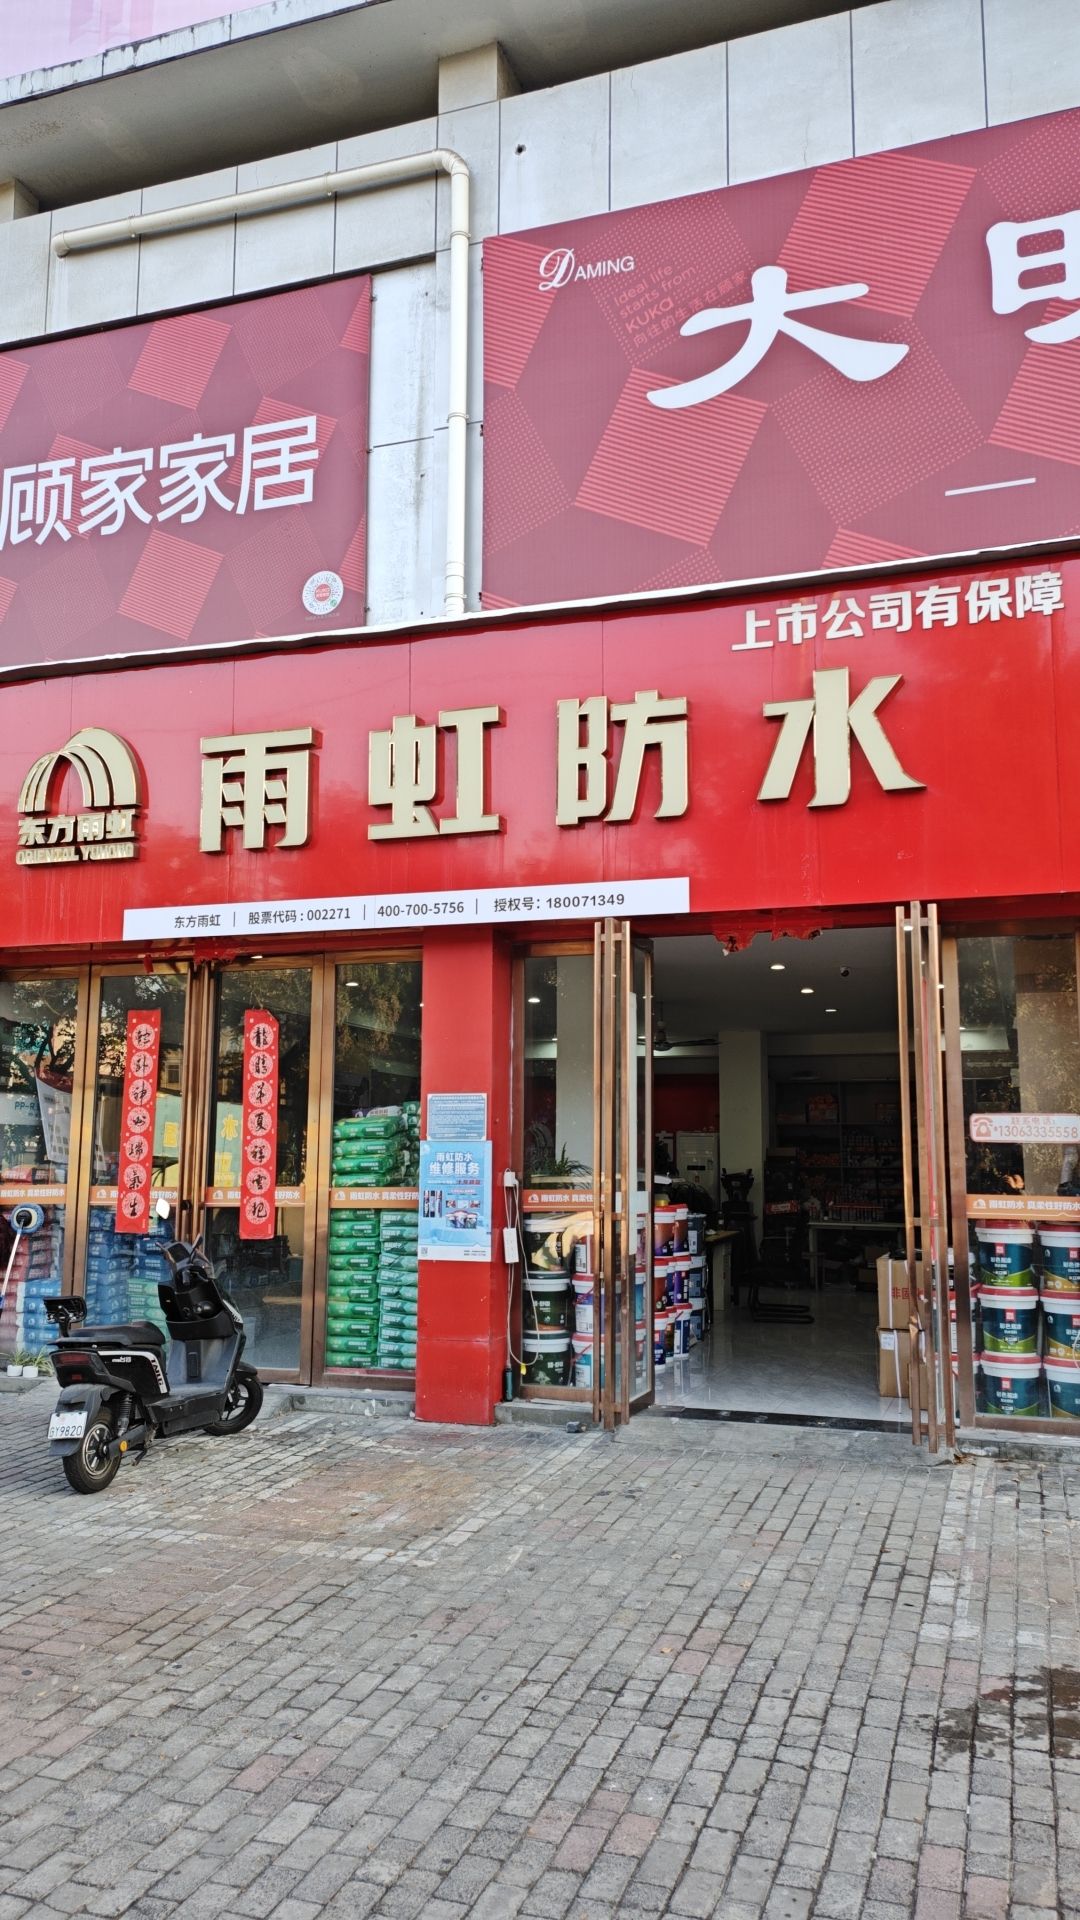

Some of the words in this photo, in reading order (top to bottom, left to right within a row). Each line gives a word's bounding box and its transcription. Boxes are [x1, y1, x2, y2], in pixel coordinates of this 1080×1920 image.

[652, 265, 674, 285] life
[620, 290, 660, 319] starts
[661, 266, 697, 294] from
[731, 571, 1065, 652] 上市公司有保障
[200, 667, 927, 853] 雨虹防水
[17, 808, 136, 846] 东方雨虹
[15, 846, 79, 865] ORIENTAL
[174, 914, 221, 929] 东方雨虹
[377, 902, 465, 917] 400-700-5756
[429, 1162, 480, 1176] 维修服务
[436, 1152, 473, 1162] 雨虹防水
